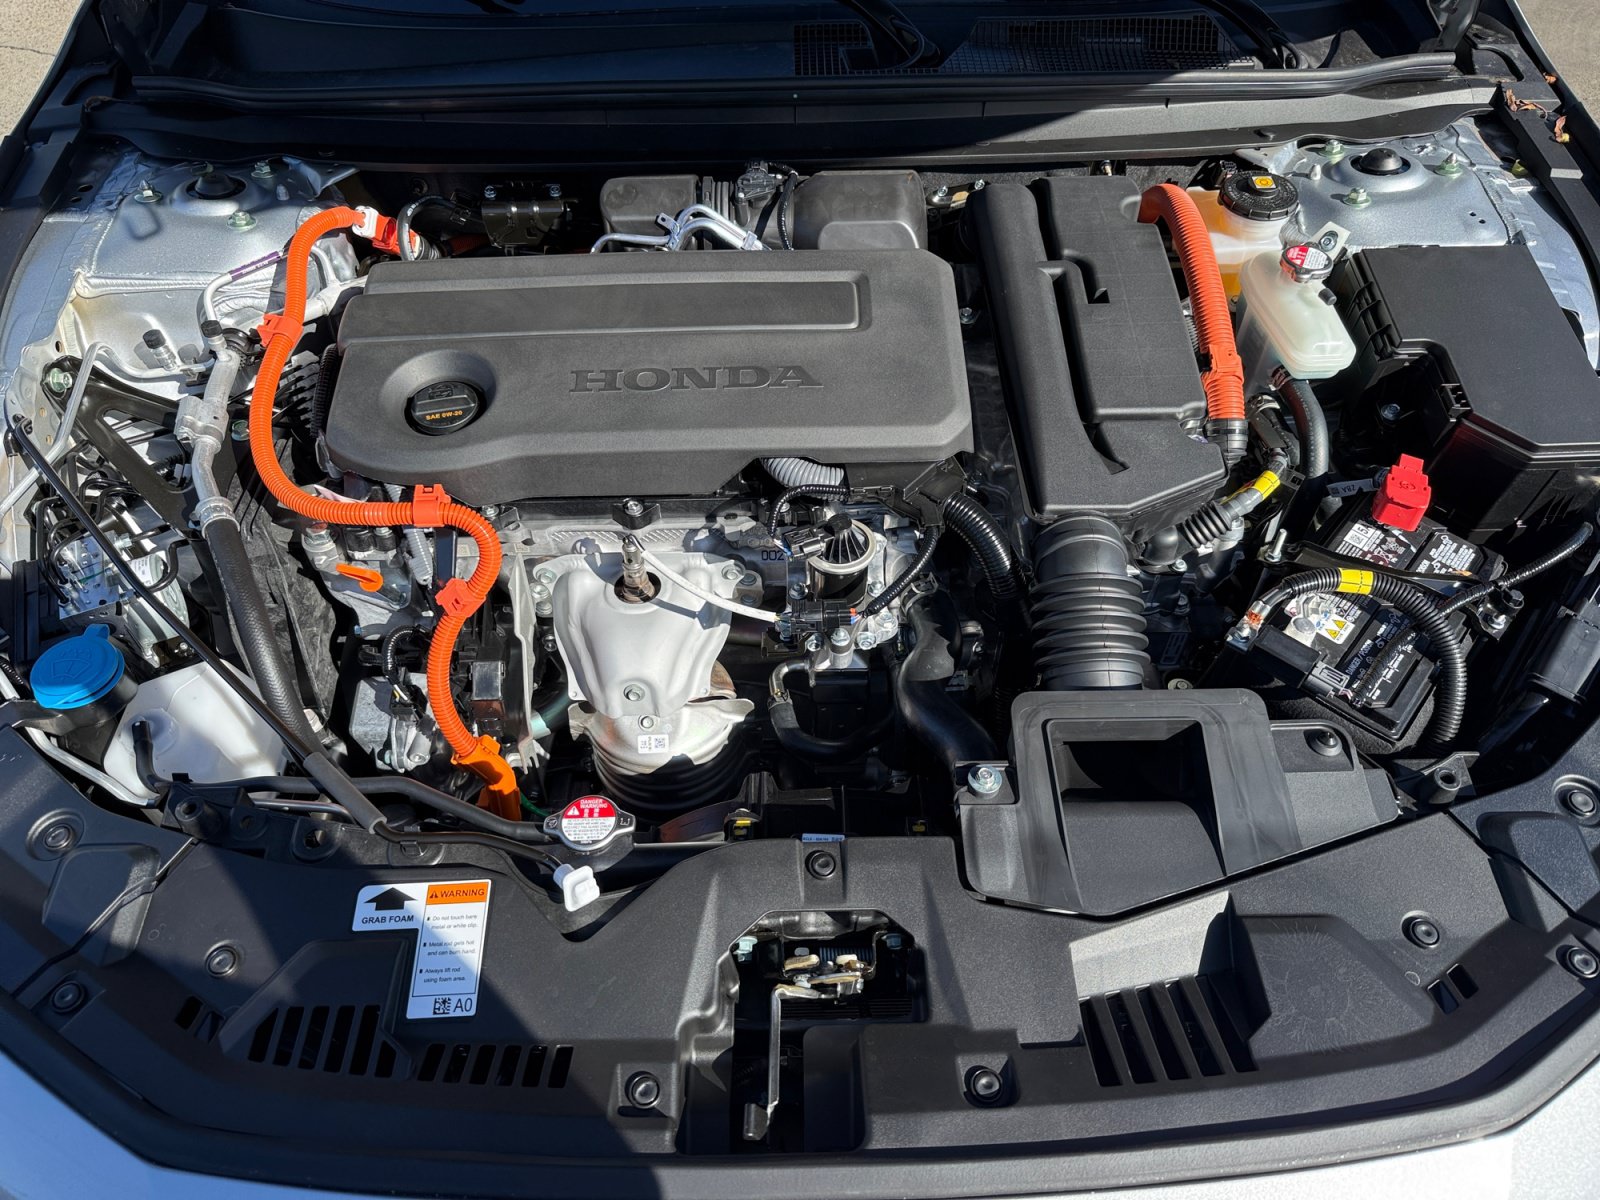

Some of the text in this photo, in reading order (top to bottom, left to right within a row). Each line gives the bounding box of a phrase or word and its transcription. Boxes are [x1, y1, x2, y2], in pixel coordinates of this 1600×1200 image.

[569, 366, 824, 392] HONDA
[762, 550, 784, 560] 002
[440, 890, 485, 898] WARNING
[362, 916, 386, 924] GRAB
[454, 998, 472, 1012] A0
